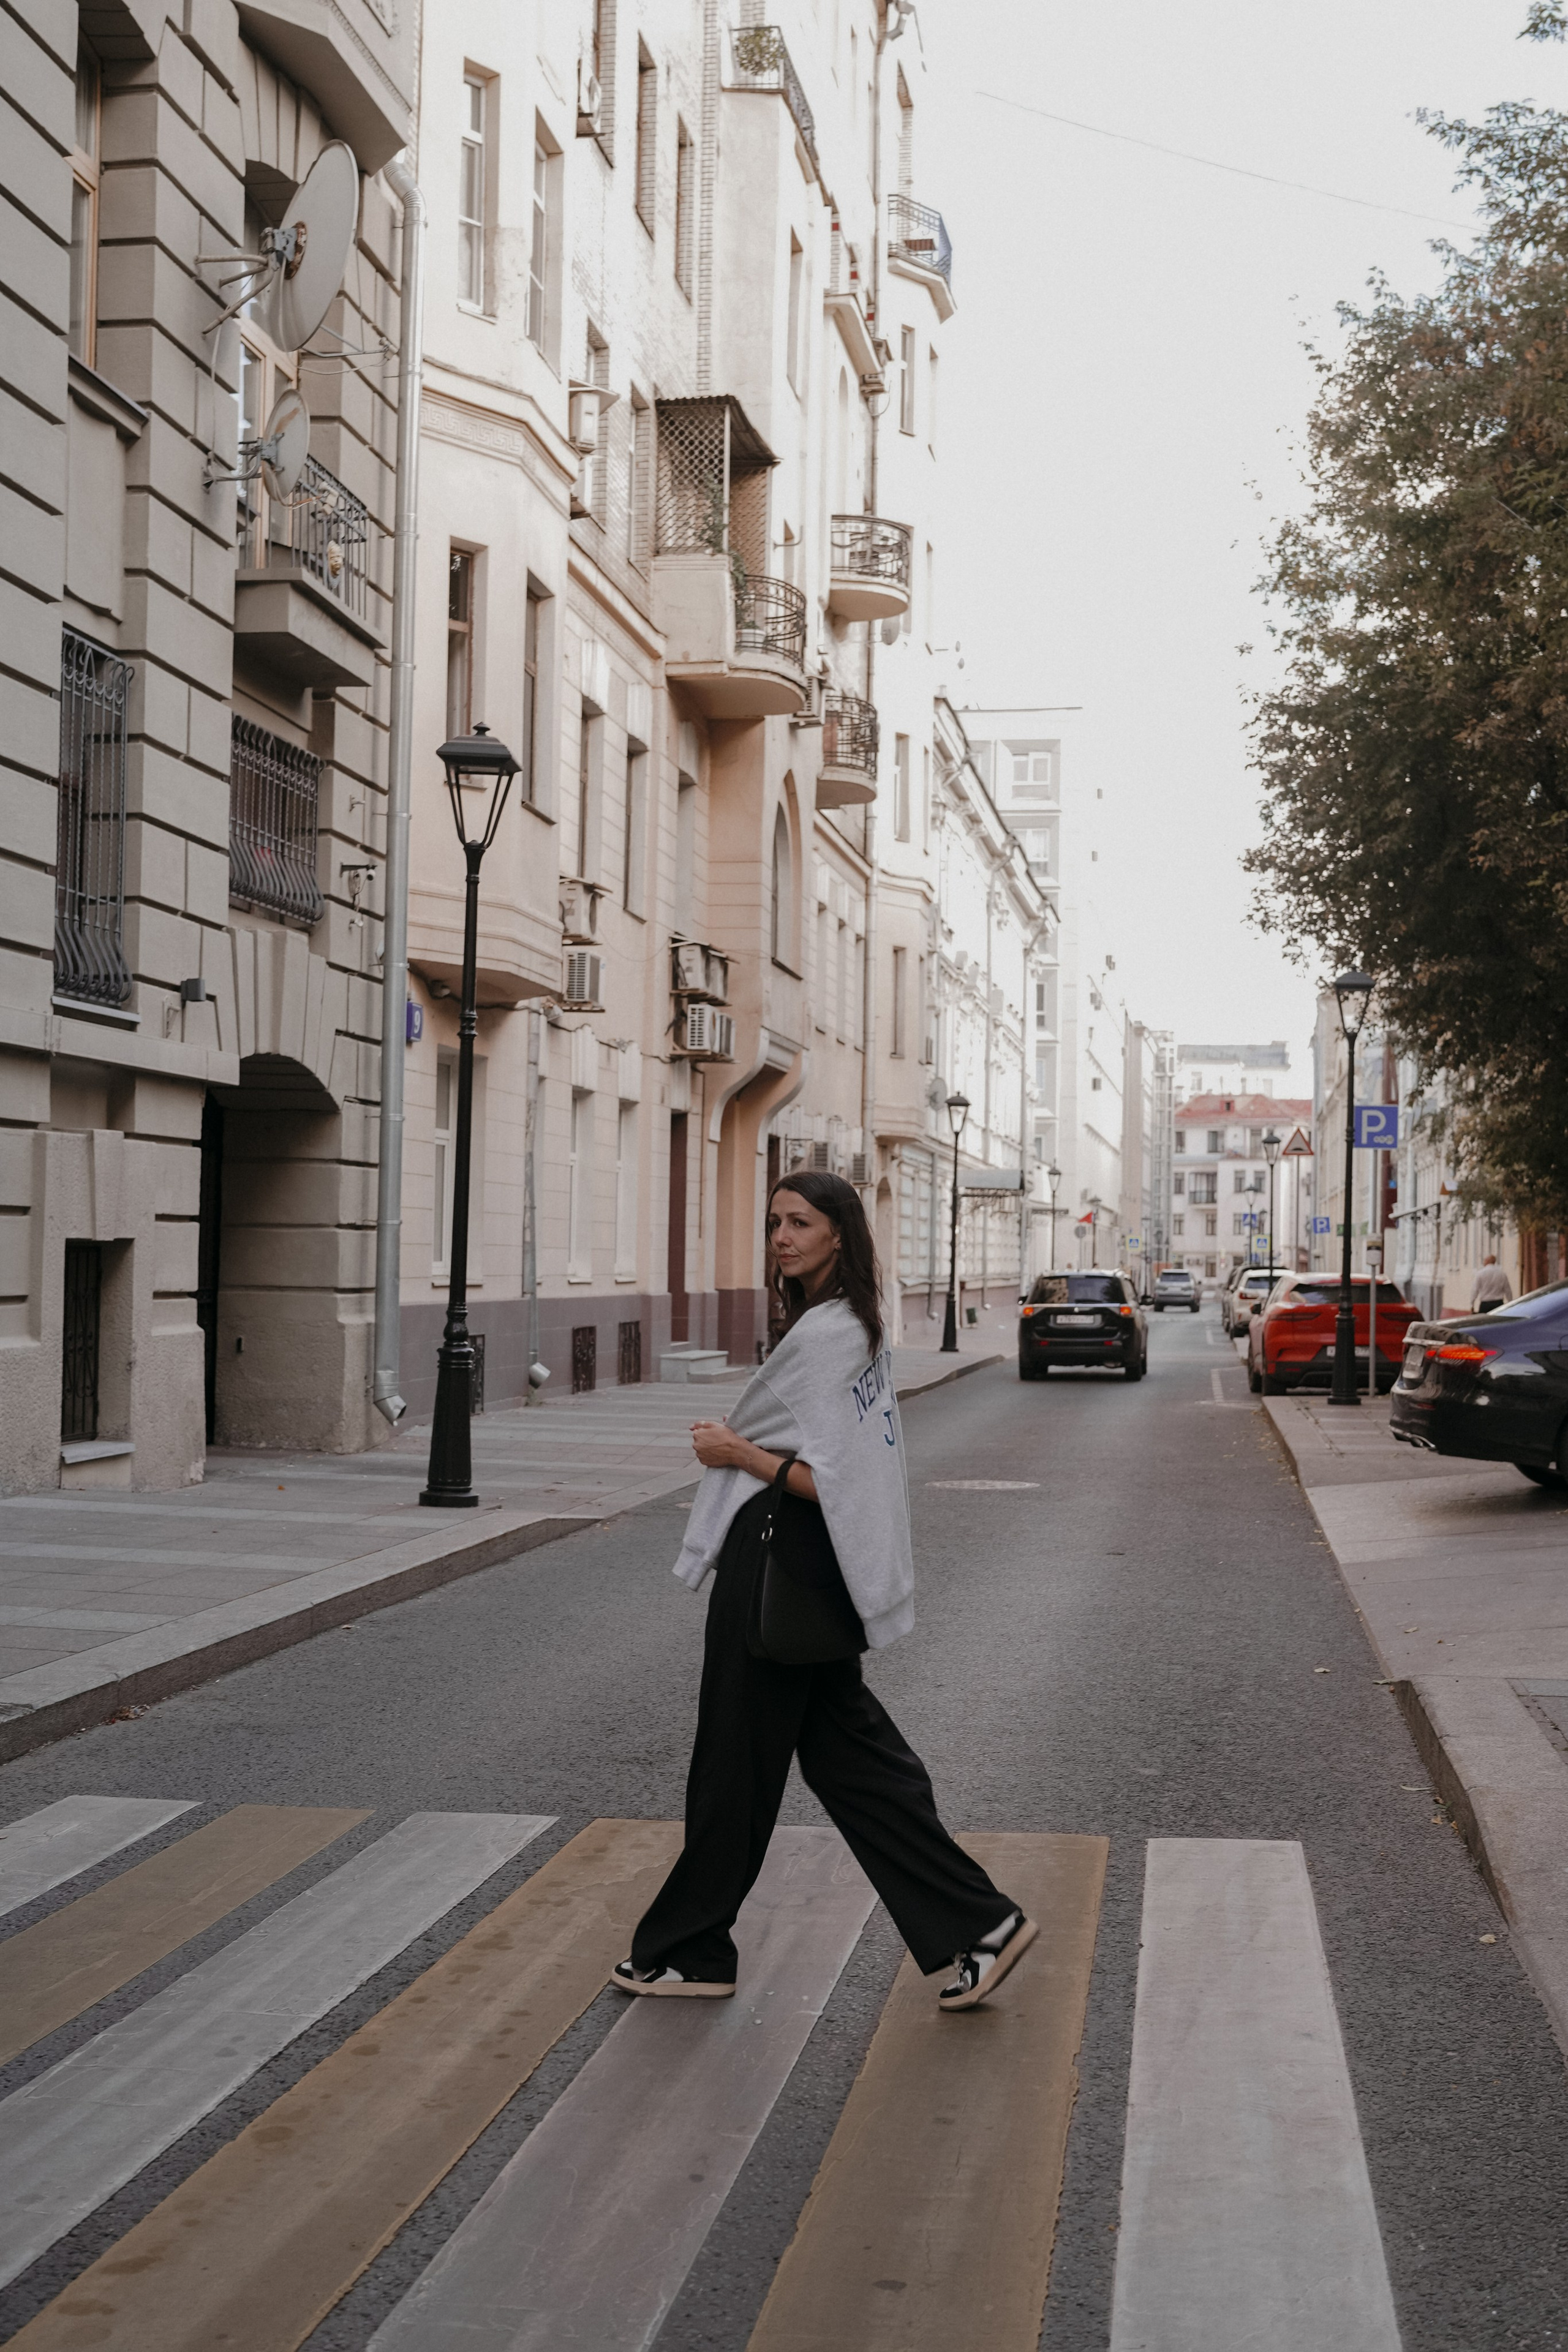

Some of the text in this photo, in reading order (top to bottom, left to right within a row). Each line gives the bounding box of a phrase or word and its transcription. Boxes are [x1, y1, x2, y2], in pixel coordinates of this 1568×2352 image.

[414, 1010, 421, 1034] 9
[1362, 1109, 1387, 1145] P
[1316, 1218, 1327, 1232] P
[852, 1353, 884, 1423] NEW
[883, 1410, 895, 1447] J
